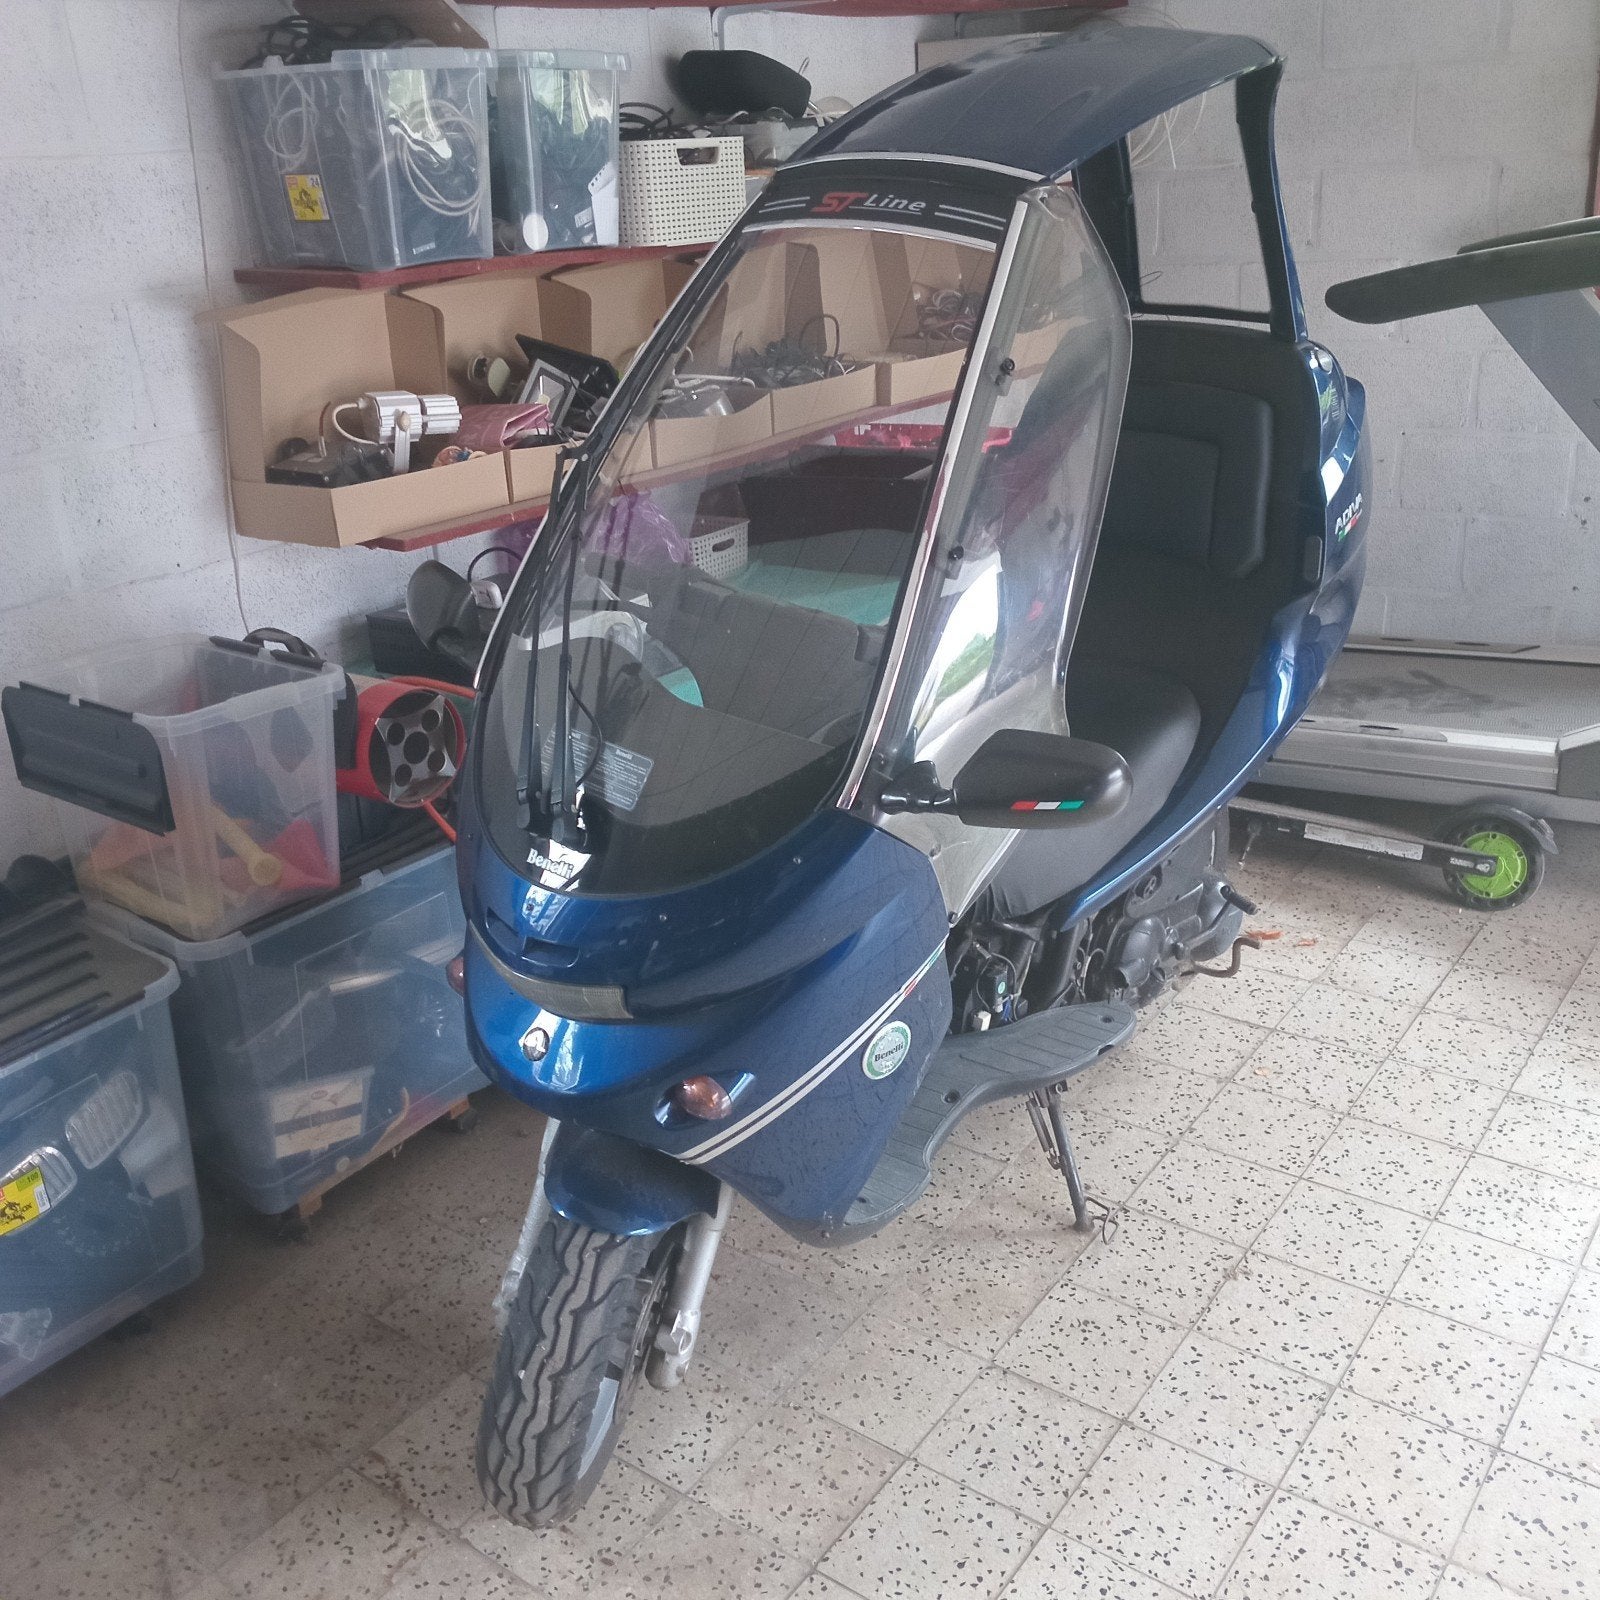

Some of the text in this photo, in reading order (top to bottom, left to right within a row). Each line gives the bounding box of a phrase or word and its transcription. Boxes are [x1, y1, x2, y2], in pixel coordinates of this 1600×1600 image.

[811, 191, 927, 213] ST Line
[526, 847, 574, 880] Benelli
[874, 1042, 904, 1062] Benelli
